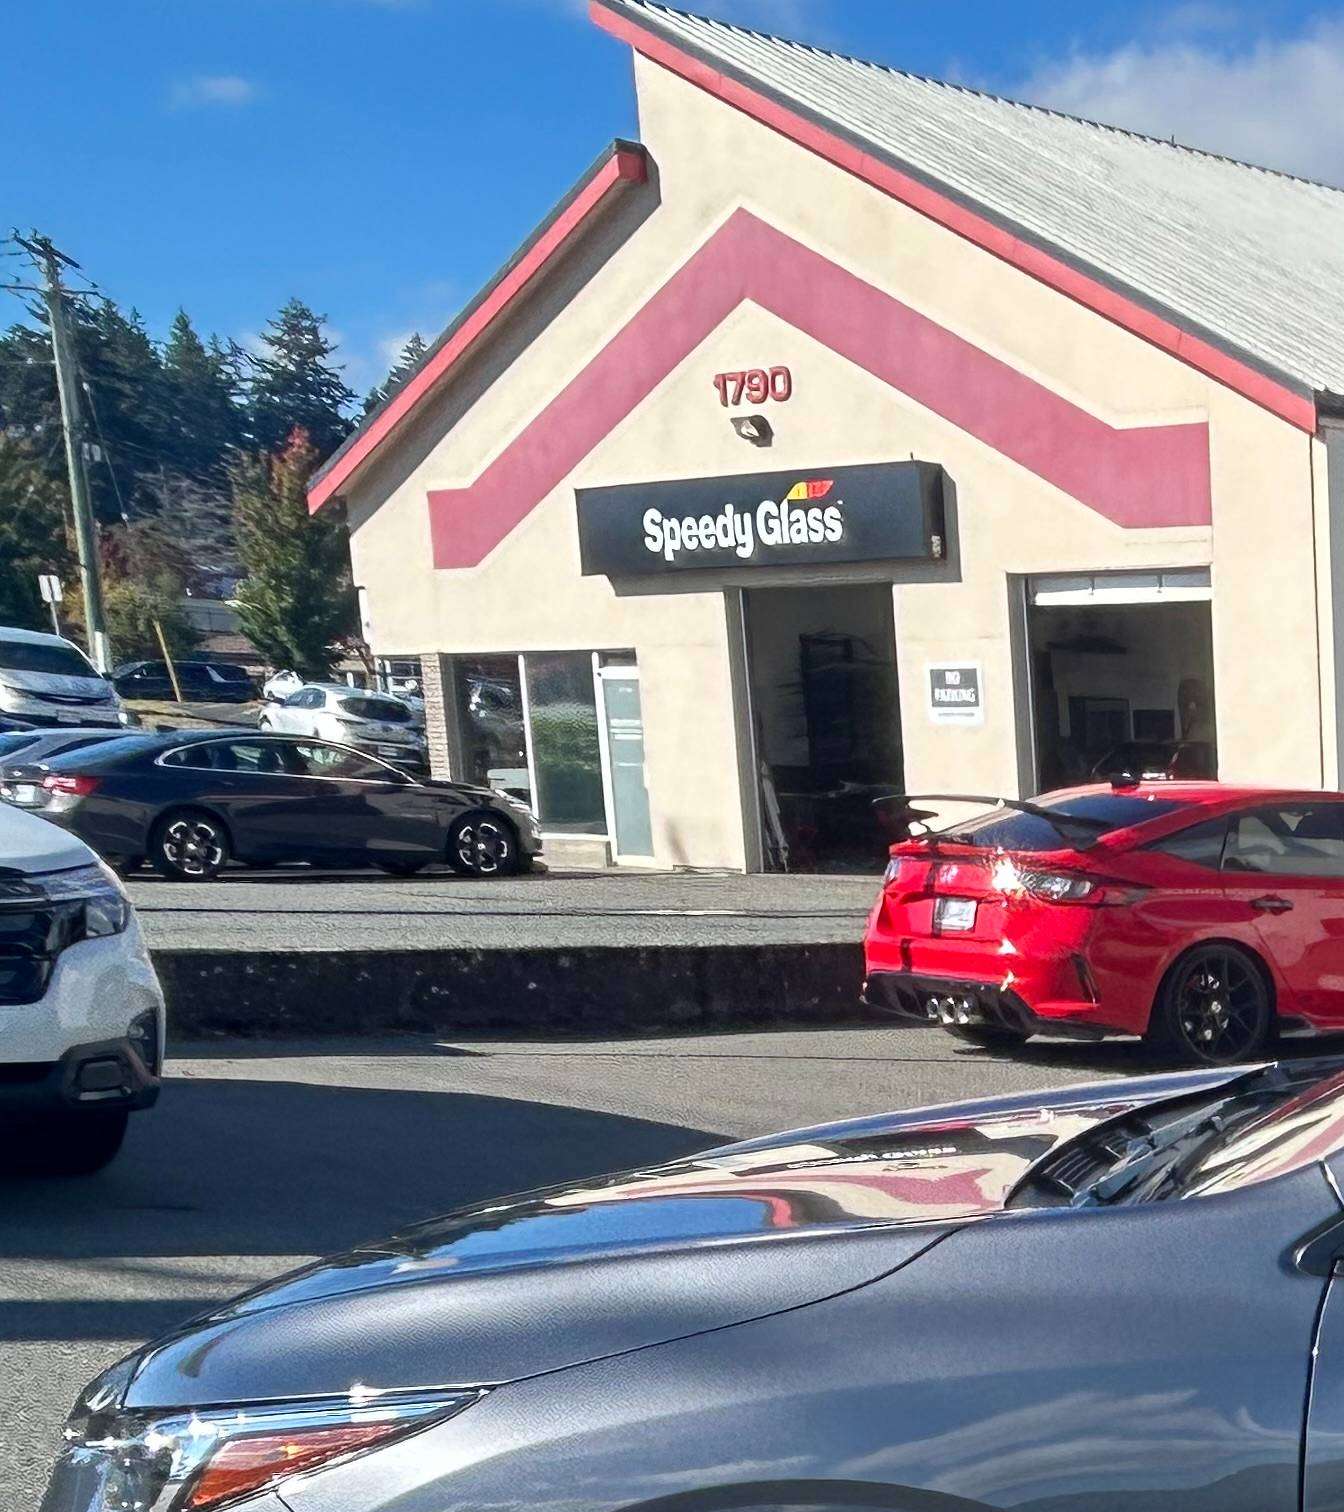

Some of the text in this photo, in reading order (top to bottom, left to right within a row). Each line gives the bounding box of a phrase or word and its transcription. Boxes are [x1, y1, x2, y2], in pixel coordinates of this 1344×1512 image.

[713, 366, 792, 407] 1790
[642, 498, 843, 561] Speedy Glass
